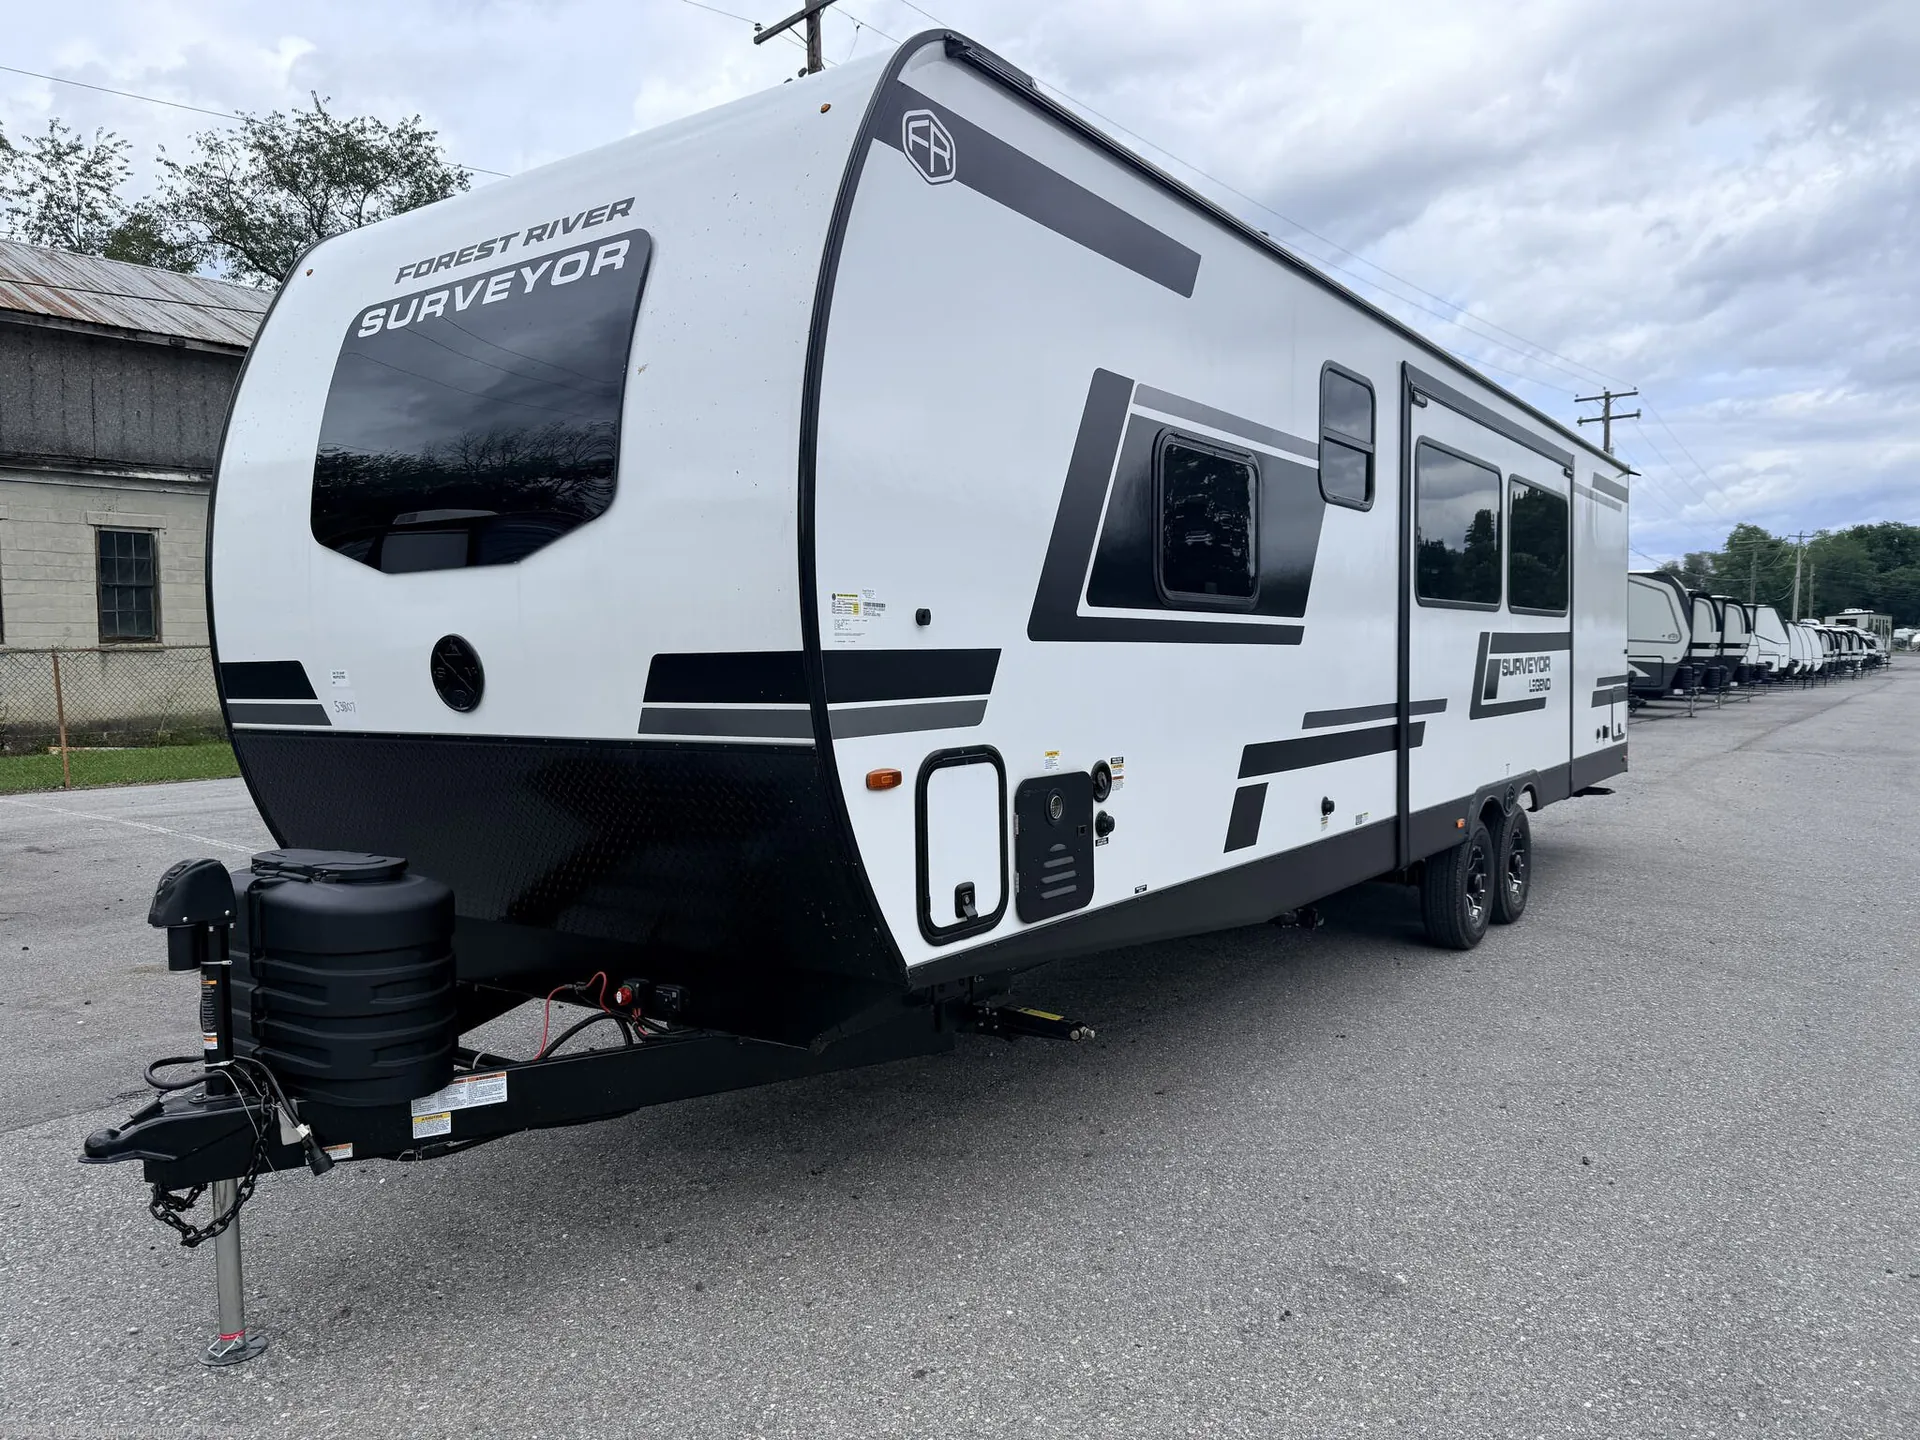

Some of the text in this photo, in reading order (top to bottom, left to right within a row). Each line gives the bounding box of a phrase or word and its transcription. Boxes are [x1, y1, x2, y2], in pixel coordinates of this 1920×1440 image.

[394, 196, 636, 285] FOREST RIVER
[357, 239, 631, 338] SURVEYOR
[1502, 656, 1551, 676] SURVEYOR
[1529, 678, 1551, 692] LEGEND
